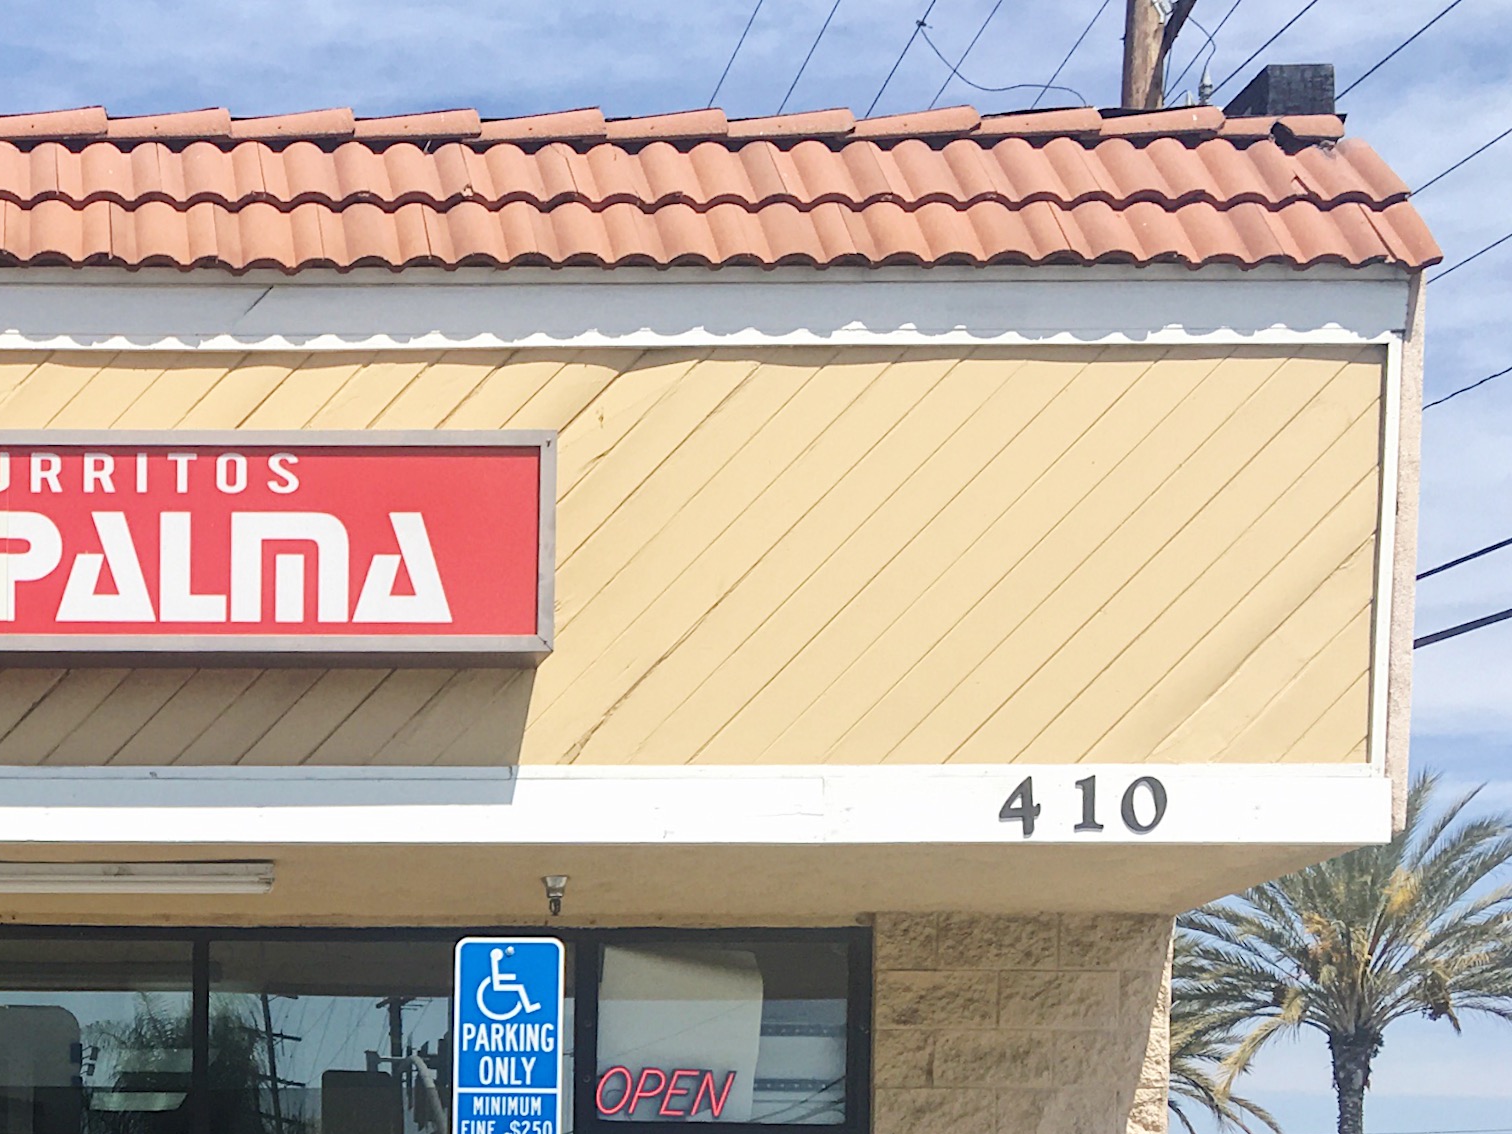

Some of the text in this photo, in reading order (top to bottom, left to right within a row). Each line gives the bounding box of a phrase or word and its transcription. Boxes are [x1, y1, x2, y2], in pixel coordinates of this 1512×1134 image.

[998, 775, 1168, 838] 410
[462, 1023, 554, 1052] PARKING
[479, 1056, 537, 1085] ONLY
[595, 1064, 737, 1118] OPEN
[473, 1096, 542, 1116] MINIMUM
